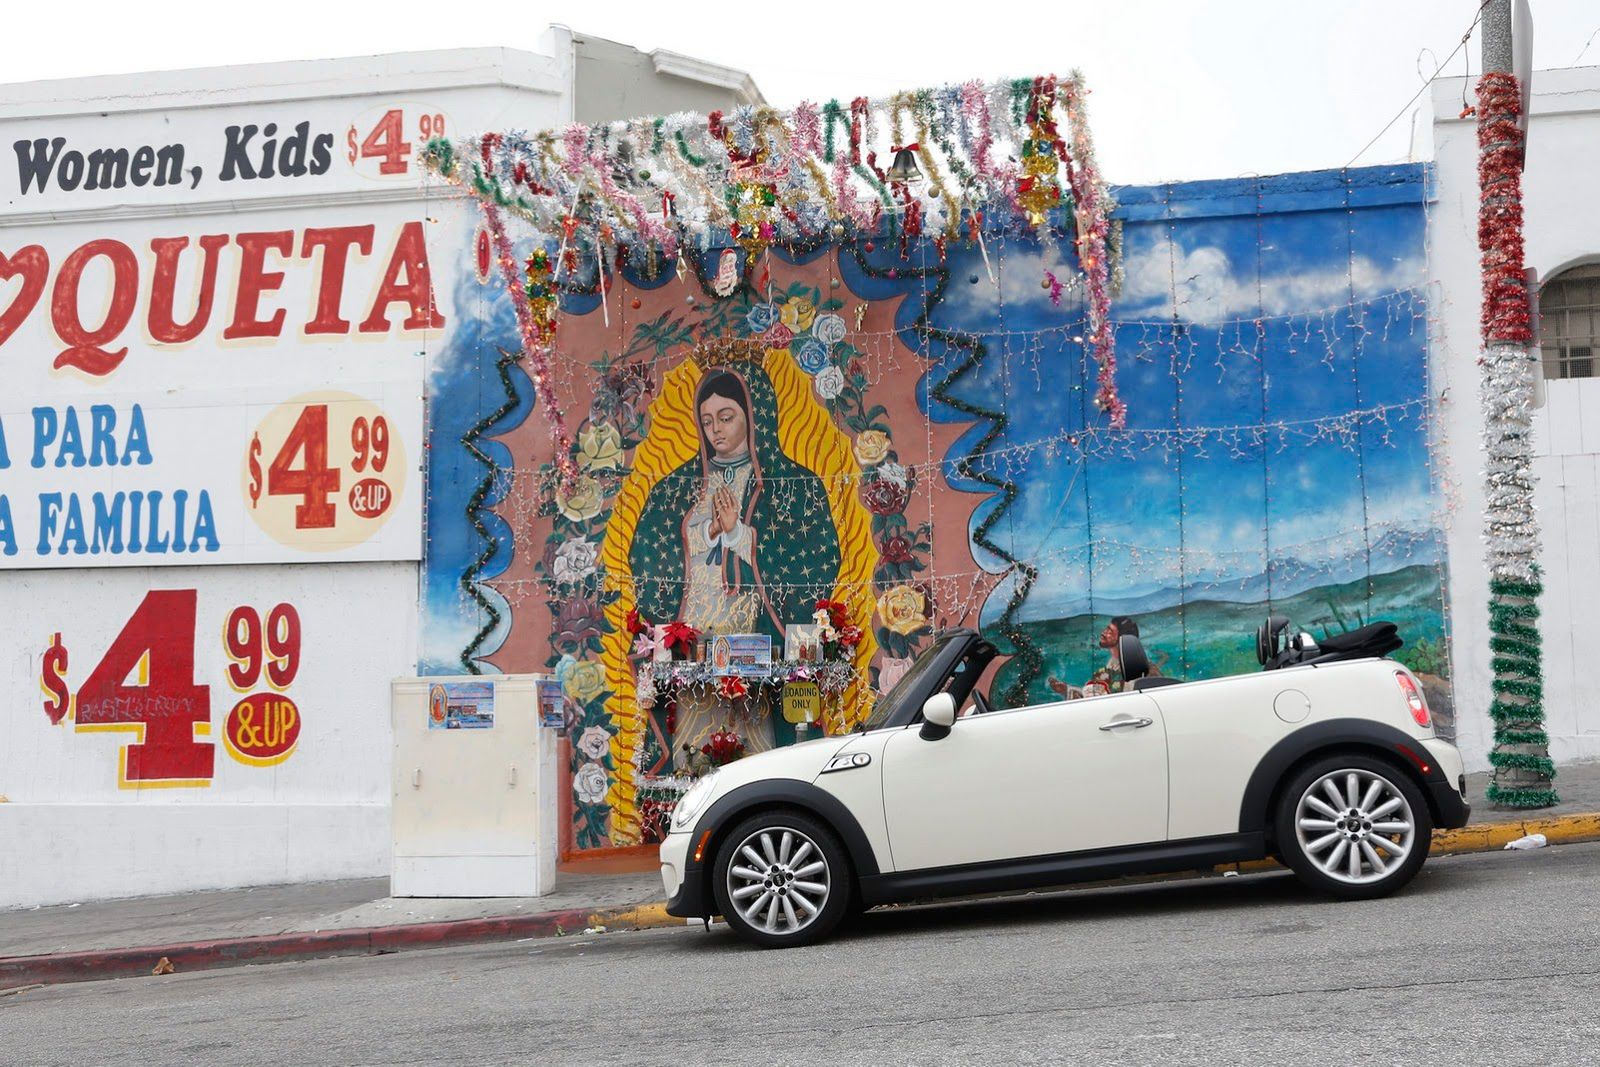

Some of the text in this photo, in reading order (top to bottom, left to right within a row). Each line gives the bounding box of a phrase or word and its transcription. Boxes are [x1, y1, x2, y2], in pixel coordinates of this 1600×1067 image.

[13, 121, 334, 195] Women, Kids
[31, 404, 154, 469] PARA
[37, 489, 221, 556] FAMILIA
[784, 687, 817, 698] LOADING
[791, 699, 811, 709] ONLY
